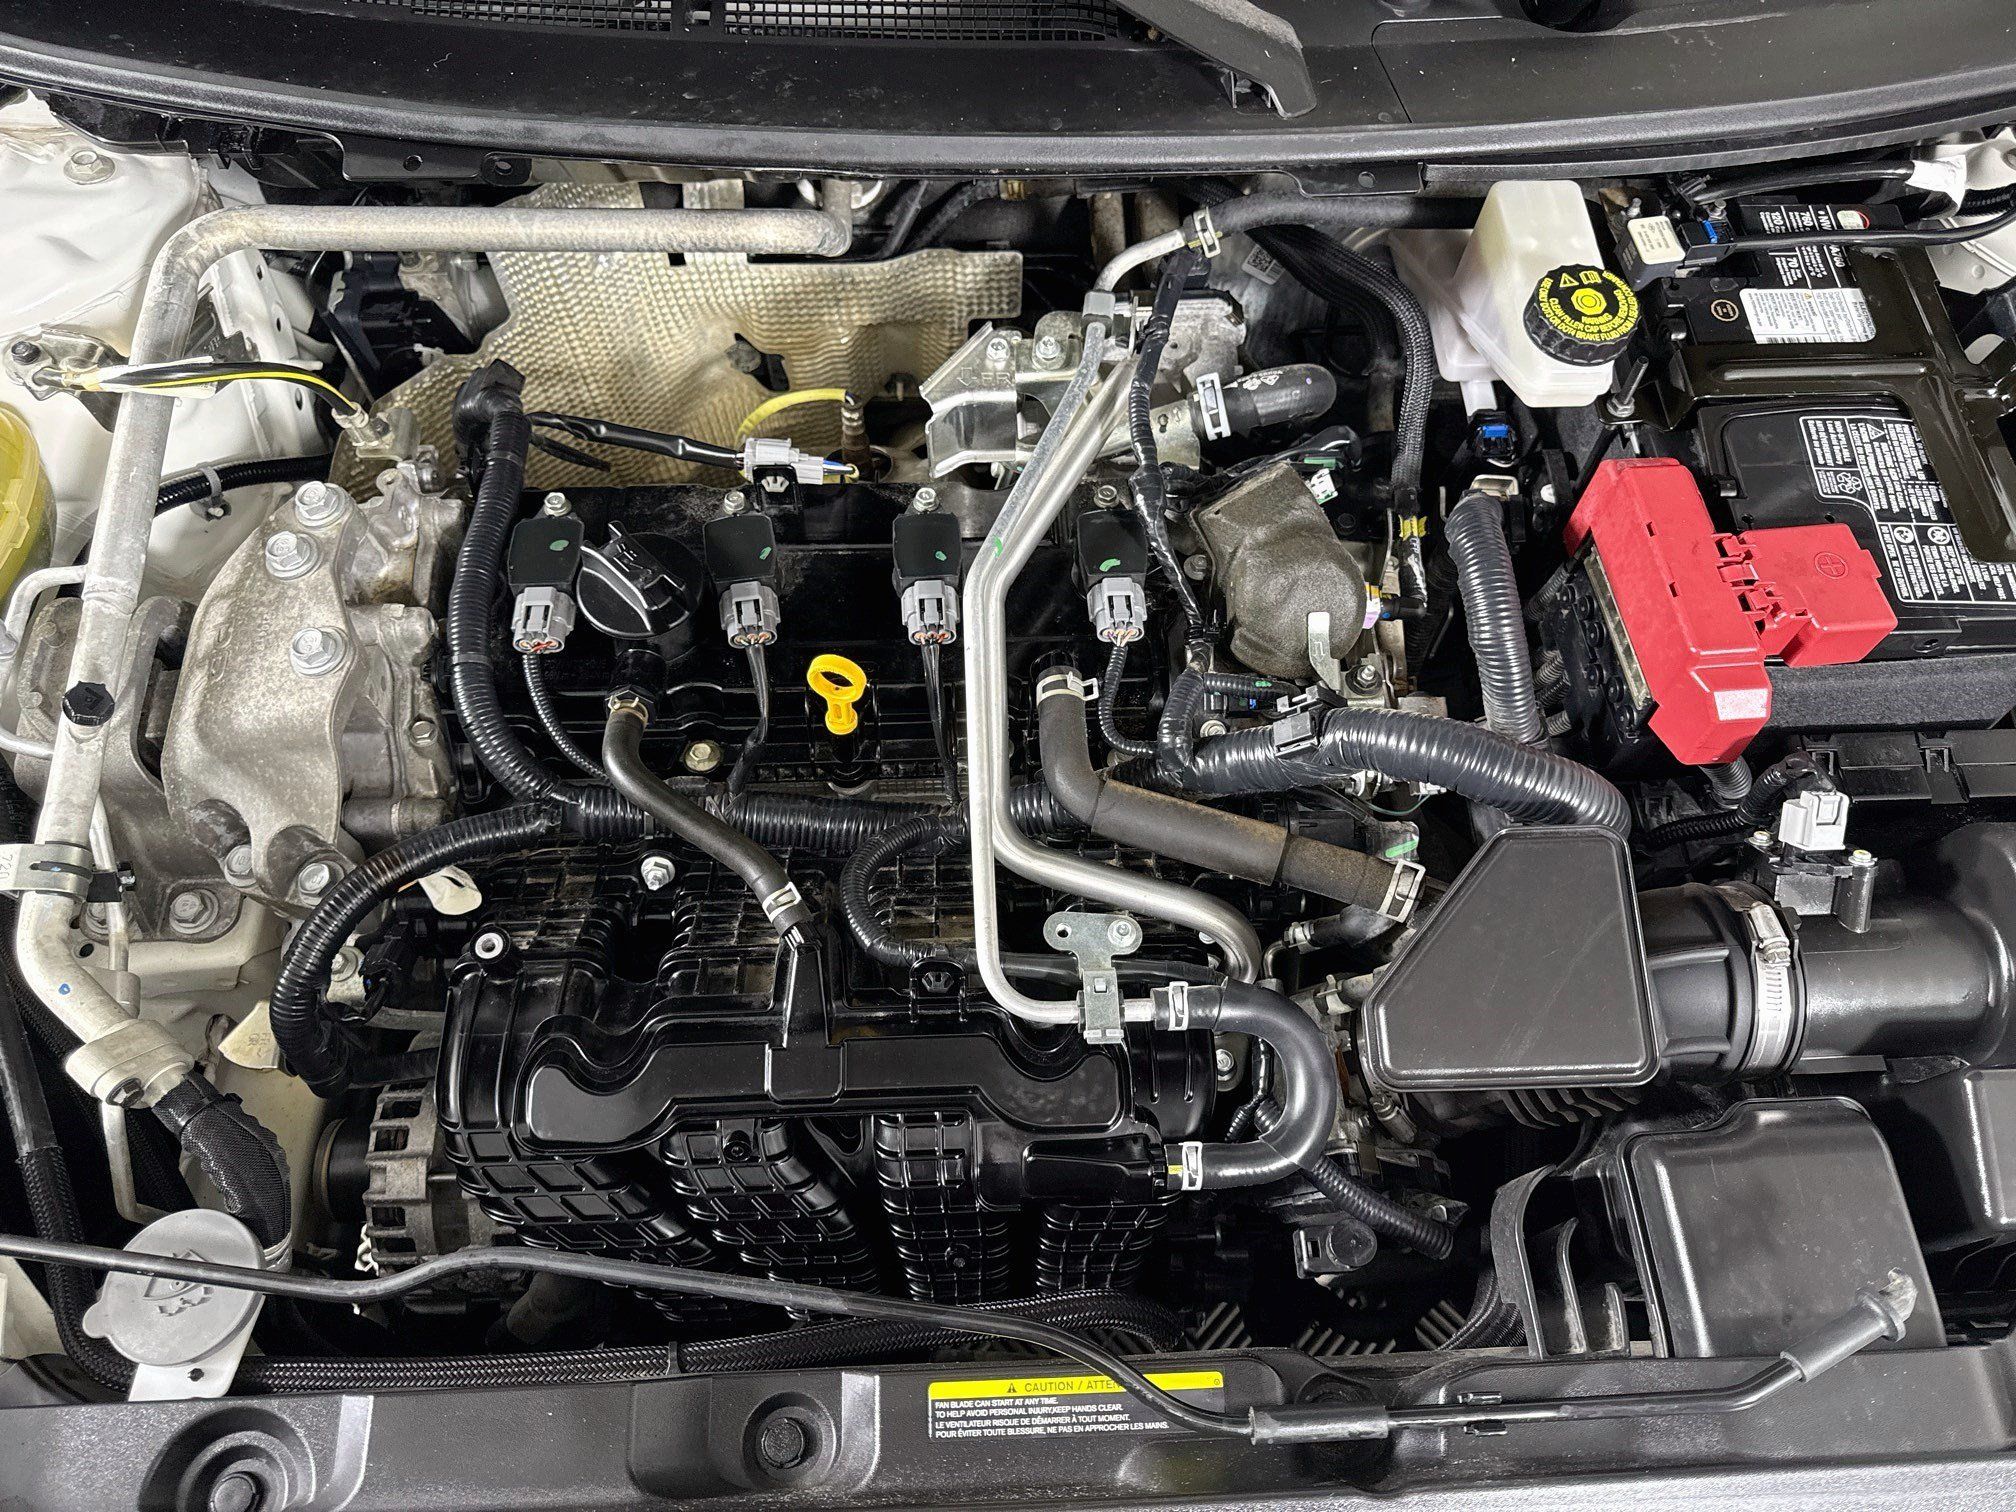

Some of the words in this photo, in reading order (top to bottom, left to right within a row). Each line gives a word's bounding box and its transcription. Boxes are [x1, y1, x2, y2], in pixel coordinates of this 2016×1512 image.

[1584, 324, 1600, 333] CAP
[1575, 330, 1601, 341] BRAKE
[1024, 1381, 1074, 1393] CAUTION
[935, 1401, 950, 1409] FAN
[950, 1400, 974, 1409] BLADE
[975, 1399, 990, 1407] CAN
[991, 1398, 1013, 1407] START
[1014, 1398, 1024, 1406] AT
[1024, 1397, 1040, 1405] ANY
[935, 1410, 946, 1418] TO
[946, 1410, 966, 1418] HELP
[966, 1409, 988, 1417] AVOID
[989, 1407, 1027, 1416] PERSONAL
[1072, 1404, 1097, 1413] HANDS
[1098, 1404, 1123, 1412] CLEAR.
[935, 1421, 945, 1429] LE
[945, 1419, 991, 1428] VENTILATEUR
[992, 1418, 1019, 1427] RISQUE
[1032, 1416, 1071, 1425] DÉMARRER
[1078, 1414, 1097, 1423] TOUT
[1098, 1413, 1131, 1422] MOMENT.
[935, 1430, 957, 1438] POUR
[957, 1428, 982, 1438] ÉVITER
[983, 1428, 1006, 1437] TOUTE
[1007, 1426, 1046, 1436] BLESSURE,
[1047, 1426, 1058, 1434] NE
[1058, 1425, 1073, 1434] PAS
[1074, 1425, 1084, 1433] EN
[1084, 1422, 1130, 1432] APPROCHER
[1130, 1422, 1144, 1430] LES
[1145, 1421, 1170, 1429] MAINS.
